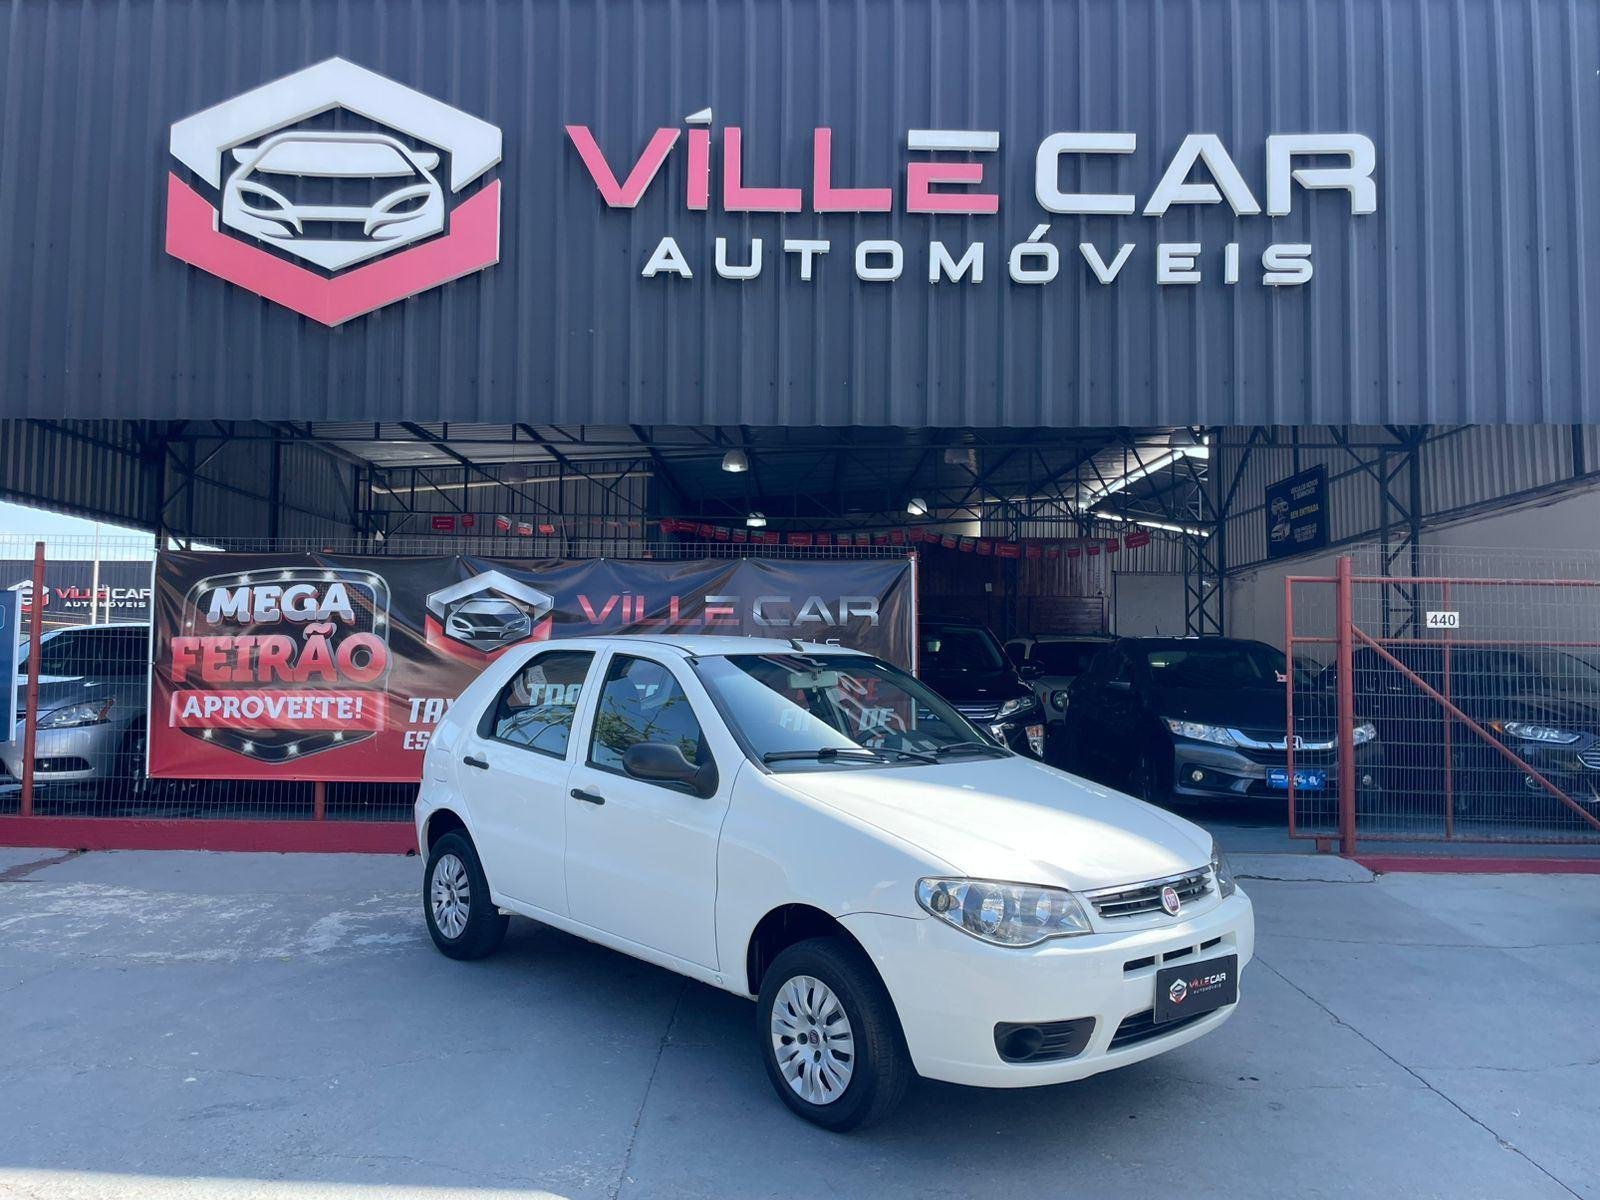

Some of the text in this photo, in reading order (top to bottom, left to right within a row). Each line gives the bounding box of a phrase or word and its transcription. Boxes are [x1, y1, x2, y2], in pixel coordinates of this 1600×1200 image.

[565, 107, 1377, 216] VÍLLE CAR
[641, 223, 1314, 287] AUTOMÓVEIS
[206, 583, 355, 625] MEGA
[752, 595, 880, 627] CAR
[1430, 614, 1456, 626] 440
[171, 622, 390, 684] FEIRÃO
[182, 695, 363, 720] APROVEITE!
